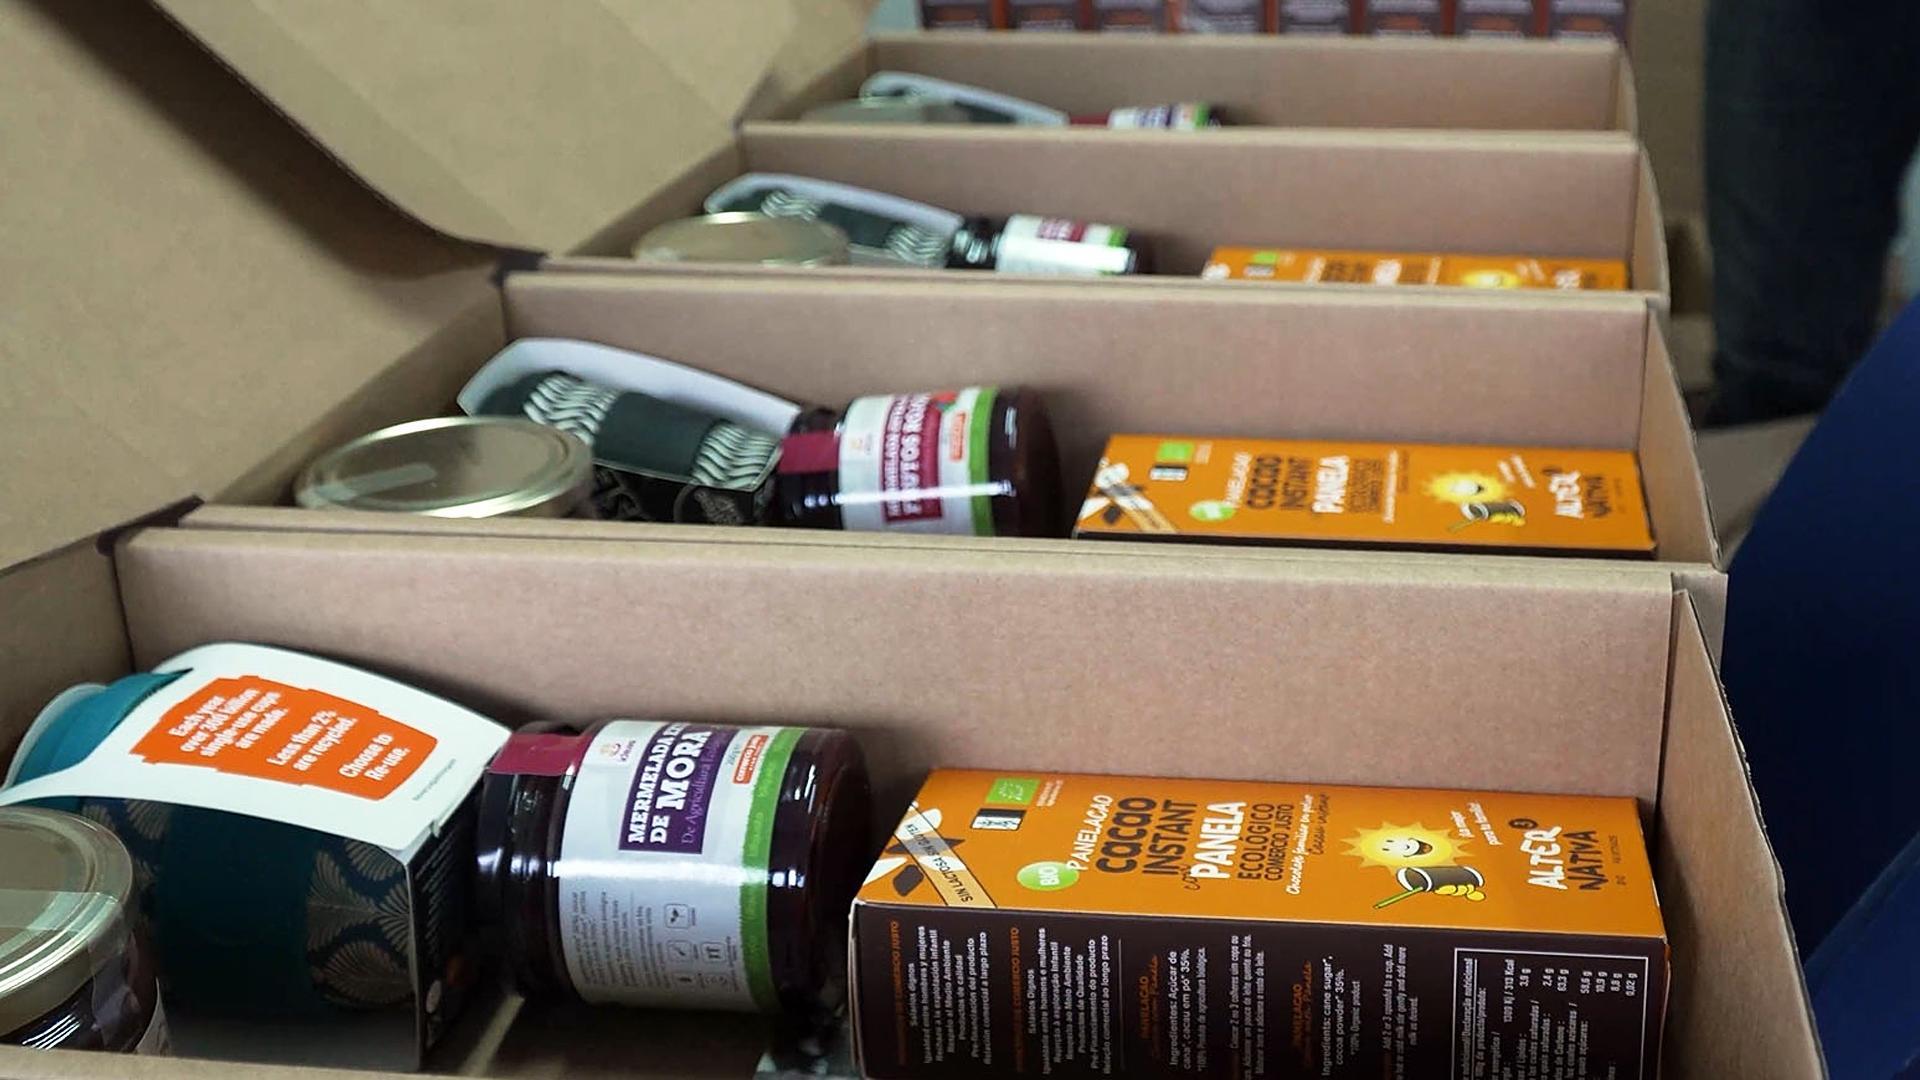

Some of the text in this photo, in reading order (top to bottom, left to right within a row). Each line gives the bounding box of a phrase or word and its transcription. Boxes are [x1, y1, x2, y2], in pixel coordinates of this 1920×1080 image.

[168, 695, 226, 737] Each year
[200, 691, 281, 757] single-use cups
[235, 708, 289, 749] are made.
[180, 731, 210, 752] over
[266, 743, 302, 765] Less
[290, 722, 323, 745] than
[293, 717, 358, 771] are recycled.
[338, 733, 393, 778] Choose to
[364, 748, 411, 781] Re-use.
[627, 737, 675, 843] MERMELADA
[649, 731, 713, 843] DE MORA
[1142, 799, 1197, 875] INSTANT
[1189, 802, 1247, 879] PANELA
[1238, 803, 1275, 880] ECOLÓGICO
[1264, 804, 1294, 881] COMERCIO JUSTO
[933, 857, 963, 888] LACTOSA
[1039, 867, 1060, 885] BIO
[1519, 826, 1569, 890] ALTER
[1562, 831, 1609, 890] NATIVA
[958, 888, 974, 902] SIN
[918, 926, 927, 960] mujeres
[929, 929, 938, 960] infantil
[942, 940, 950, 980] Ambiente
[966, 938, 976, 976] producto
[979, 932, 988, 956] plazo
[1038, 928, 1046, 968] mulheres
[1088, 940, 1097, 978] producto
[1101, 934, 1111, 960] prazo
[1384, 944, 1393, 958] Add
[908, 963, 917, 991] dignos
[920, 965, 928, 1004] hombres
[931, 961, 941, 1008] explotación
[954, 955, 963, 985] calidad
[968, 977, 976, 990] del
[979, 958, 989, 979] largo
[1027, 969, 1036, 999] Dignos
[1063, 946, 1071, 987] Ambiente
[1075, 954, 1084, 998] Qualidade
[1089, 979, 1097, 990] do
[1101, 961, 1110, 986] longo
[958, 987, 964, 997] de
[981, 988, 990, 1028] comercial
[1051, 973, 1060, 1019] exploração
[1064, 989, 1072, 1010] Meio
[1102, 988, 1109, 998] ao
[1168, 951, 1180, 1065] Ingredientes: Açúcar de
[1182, 993, 1190, 1009] em
[1322, 992, 1332, 1016] cane
[1182, 1011, 1191, 1040] cacau
[1320, 1018, 1333, 1076] Ingredients:
[1335, 1037, 1344, 1065] cocoa
